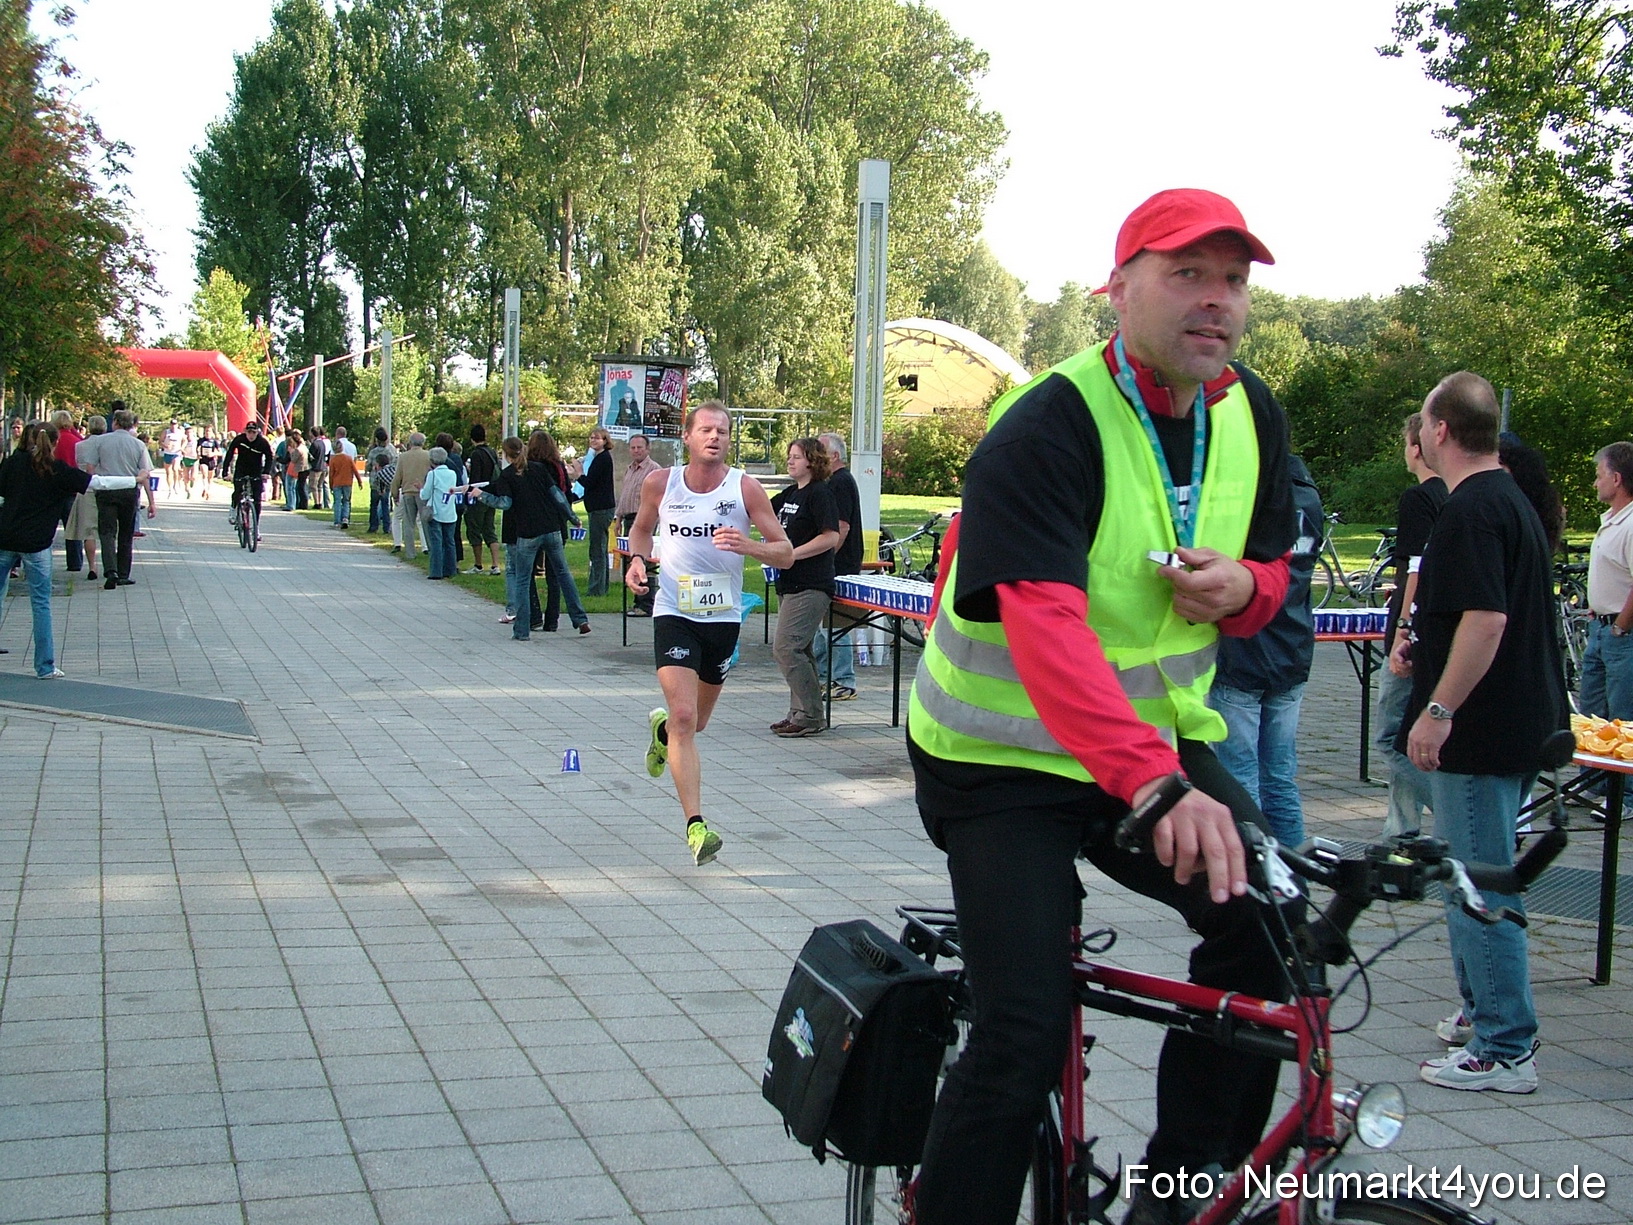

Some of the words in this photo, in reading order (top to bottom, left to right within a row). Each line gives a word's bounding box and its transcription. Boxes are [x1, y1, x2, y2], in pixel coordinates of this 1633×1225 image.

[606, 370, 633, 384] Jonas
[669, 523, 734, 537] Posit
[693, 579, 712, 587] Klaus
[699, 592, 724, 606] 401
